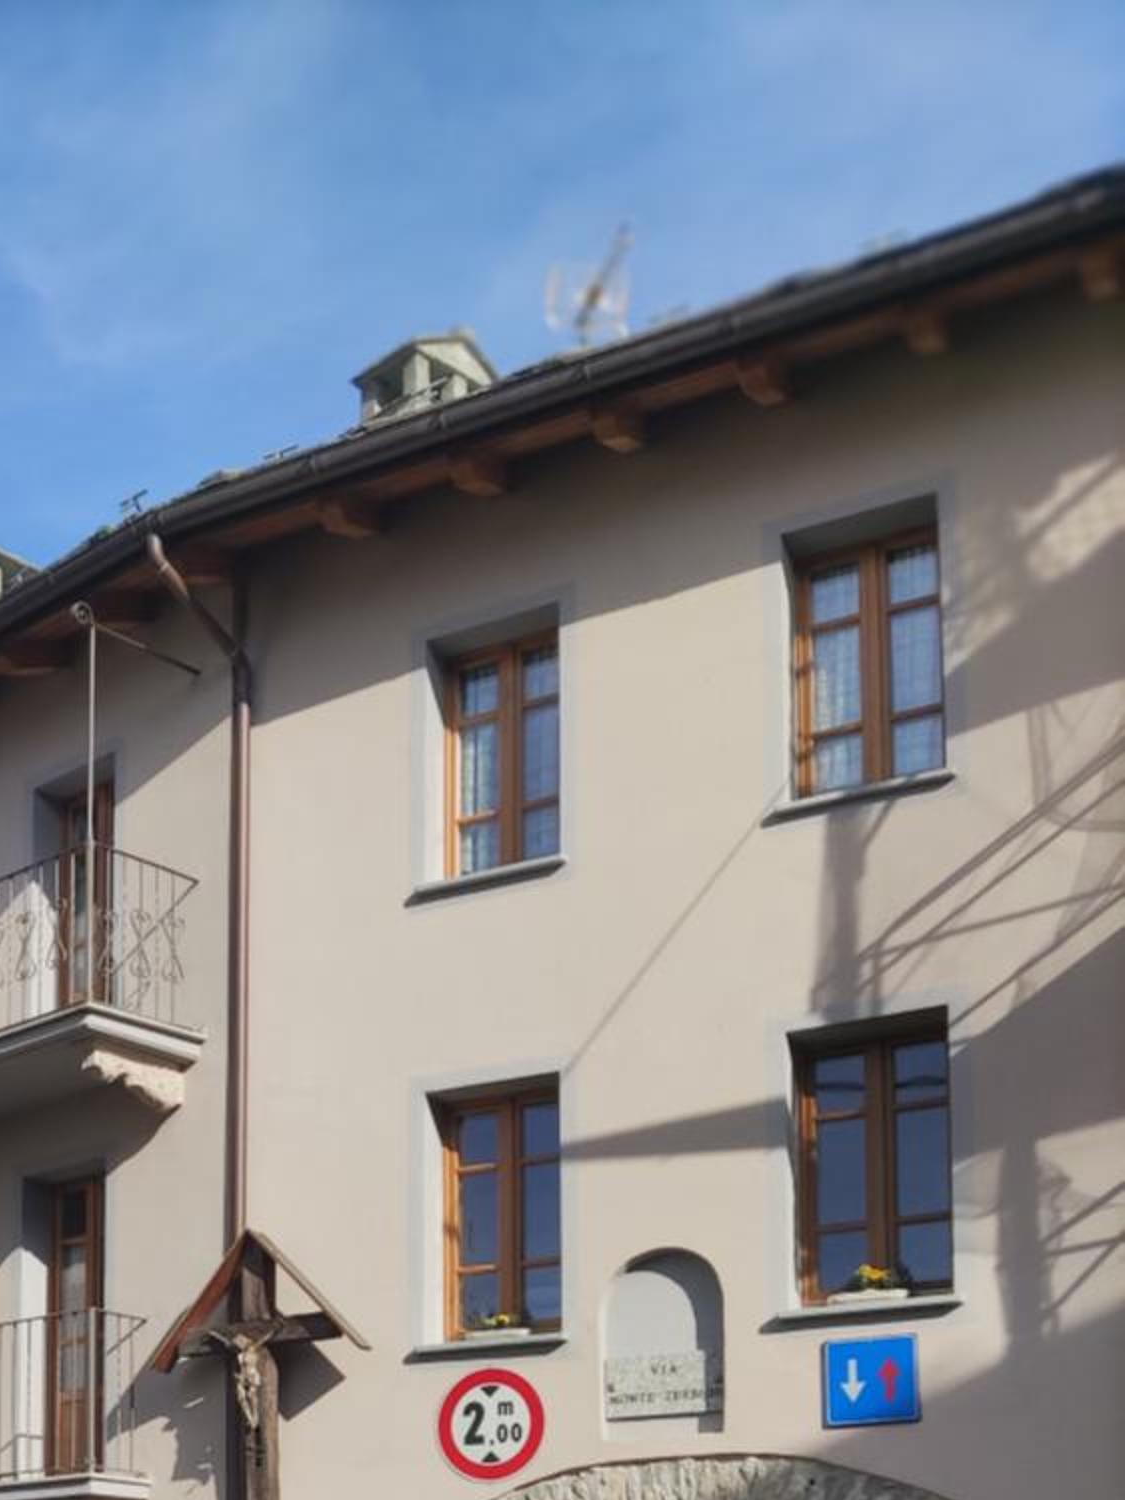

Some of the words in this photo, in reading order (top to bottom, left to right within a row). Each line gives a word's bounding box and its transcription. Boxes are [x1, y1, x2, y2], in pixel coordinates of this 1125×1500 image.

[650, 1364, 679, 1376] VIA
[610, 1391, 653, 1405] MONTE
[497, 1401, 515, 1416] m
